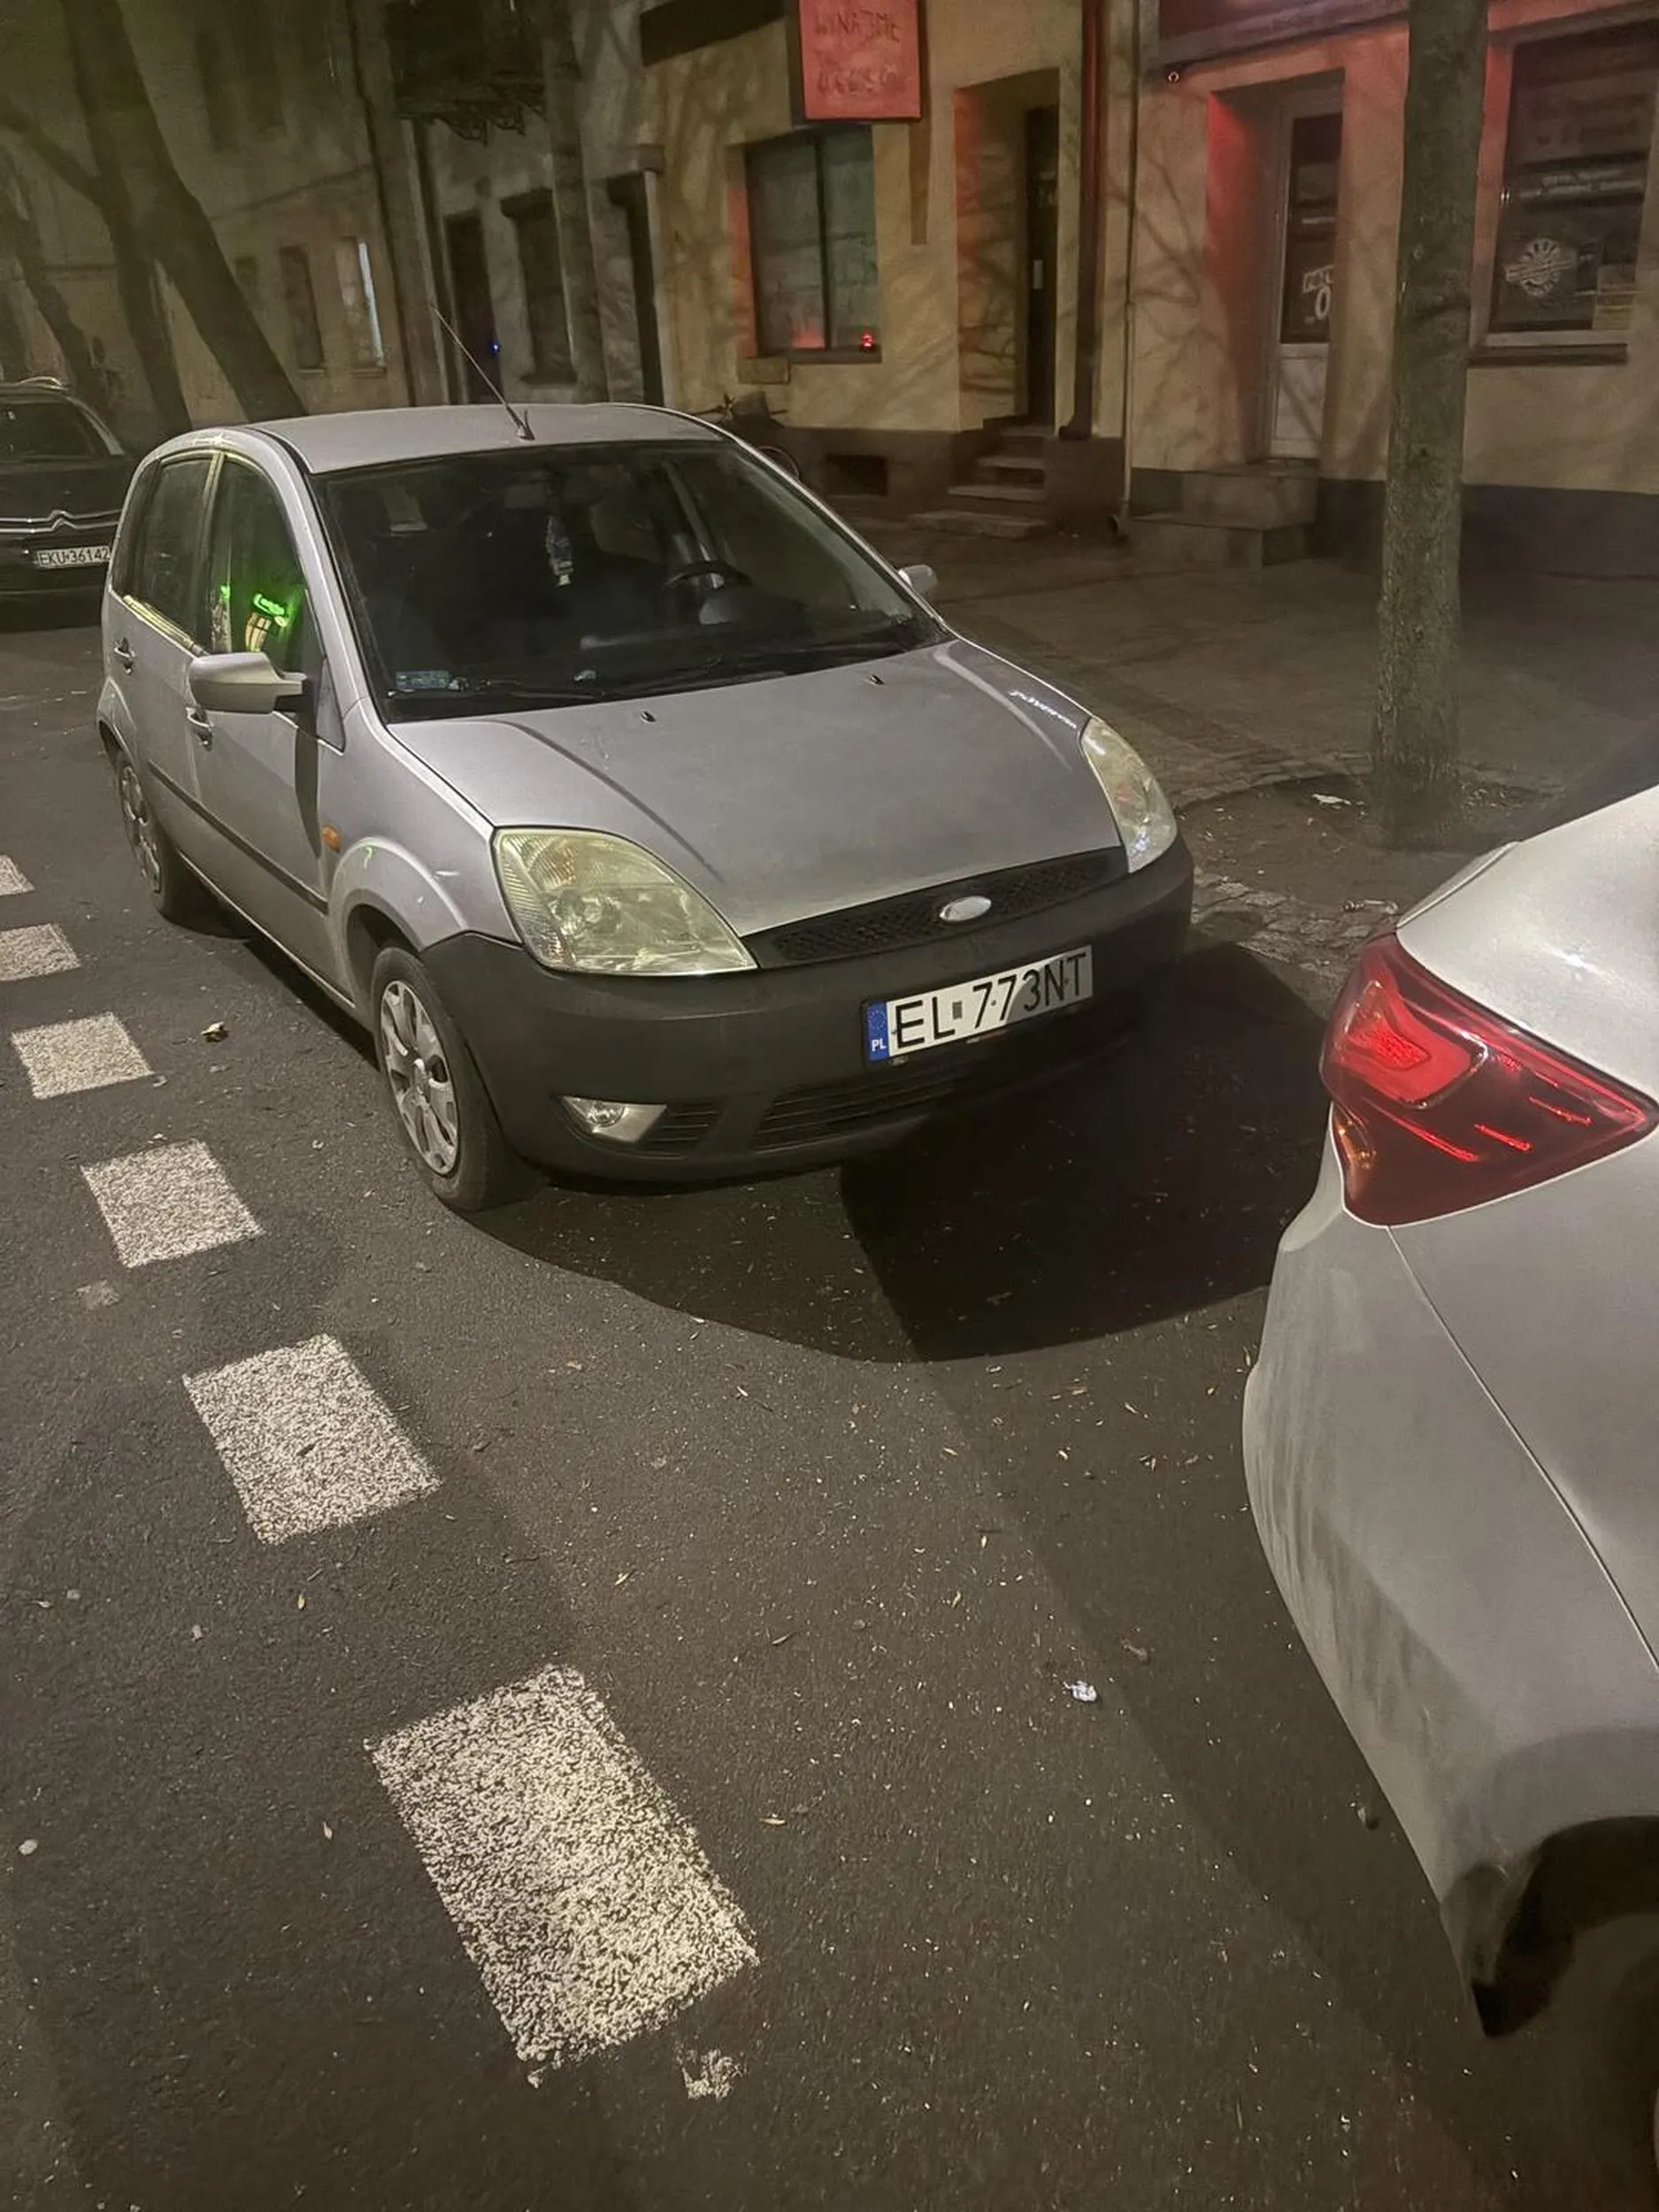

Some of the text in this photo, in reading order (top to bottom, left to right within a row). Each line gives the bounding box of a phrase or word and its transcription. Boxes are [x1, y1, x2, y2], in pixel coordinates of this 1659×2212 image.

[39, 551, 66, 565] EKU
[895, 952, 1087, 1048] EL 773NT
[872, 1039, 887, 1052] PL
